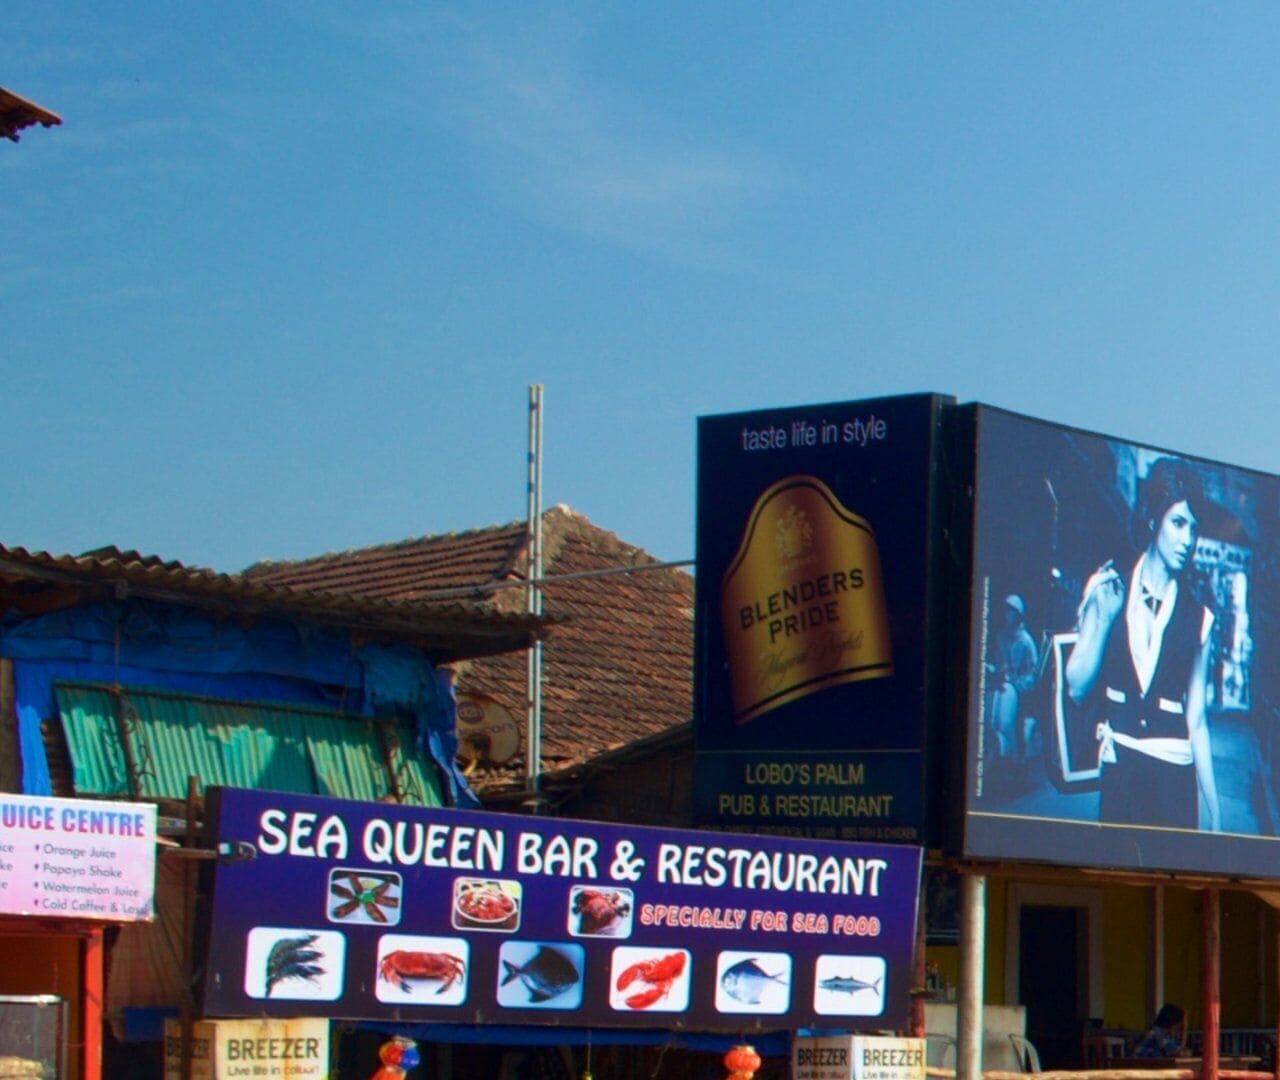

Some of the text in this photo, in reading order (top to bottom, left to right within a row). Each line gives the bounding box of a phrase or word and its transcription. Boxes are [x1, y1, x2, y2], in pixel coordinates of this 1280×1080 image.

[742, 414, 887, 450] taste life in style
[738, 568, 865, 631] BLENDERS
[767, 601, 841, 644] PRIDE
[746, 763, 865, 785] LOBO'S PALM
[718, 795, 893, 818] PUB & RESTAURANT
[2, 804, 145, 837] UICE CENTRE
[43, 843, 117, 859] Orange Juice
[258, 809, 888, 897] SEA QUEEN BAR & RESTAURANT
[43, 862, 123, 879] Papaya Shake
[42, 881, 140, 897] Watermelon Juice
[42, 898, 67, 910] Cold
[640, 904, 881, 937] SPECIALLY FOR SEA FOOD
[227, 1037, 319, 1061] BREEZER
[797, 1048, 848, 1066] BREEZER
[863, 1048, 923, 1067] BREEZER
